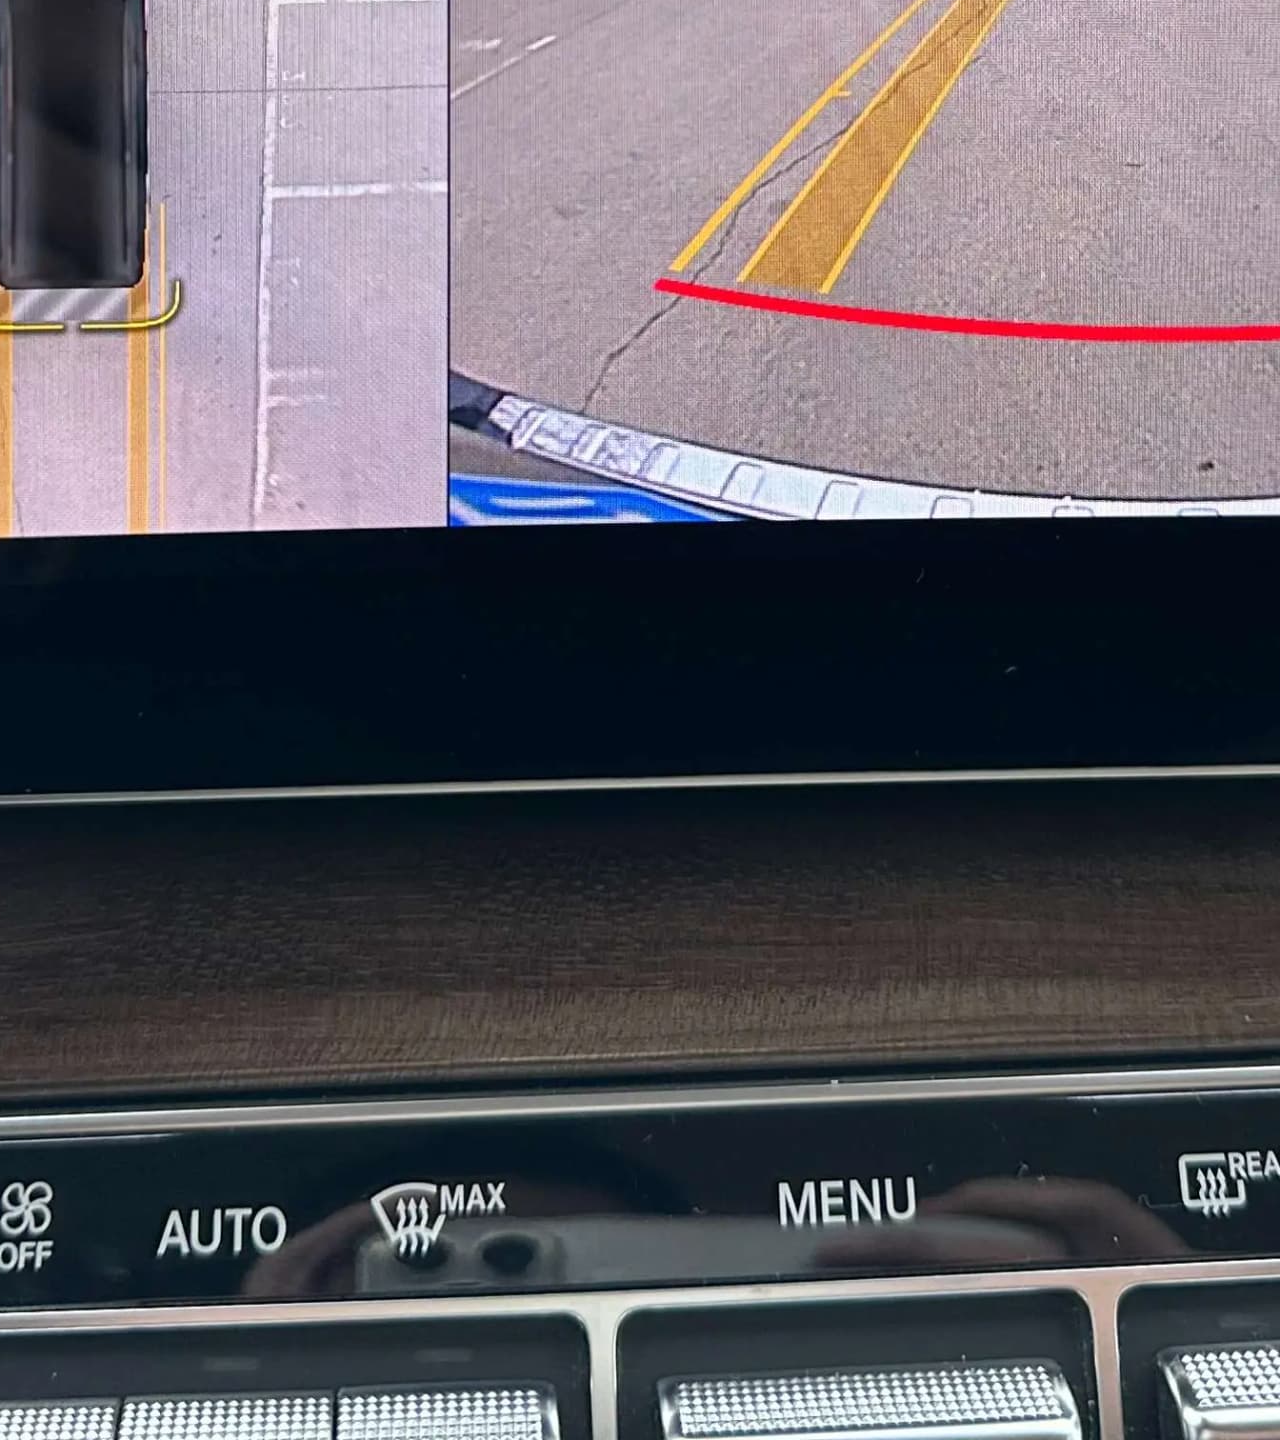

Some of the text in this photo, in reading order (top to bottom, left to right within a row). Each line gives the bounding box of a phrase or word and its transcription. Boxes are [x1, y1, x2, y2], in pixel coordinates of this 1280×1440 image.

[439, 1182, 507, 1215] MAX
[777, 1176, 917, 1227] MENU
[156, 1206, 288, 1257] AUTO
